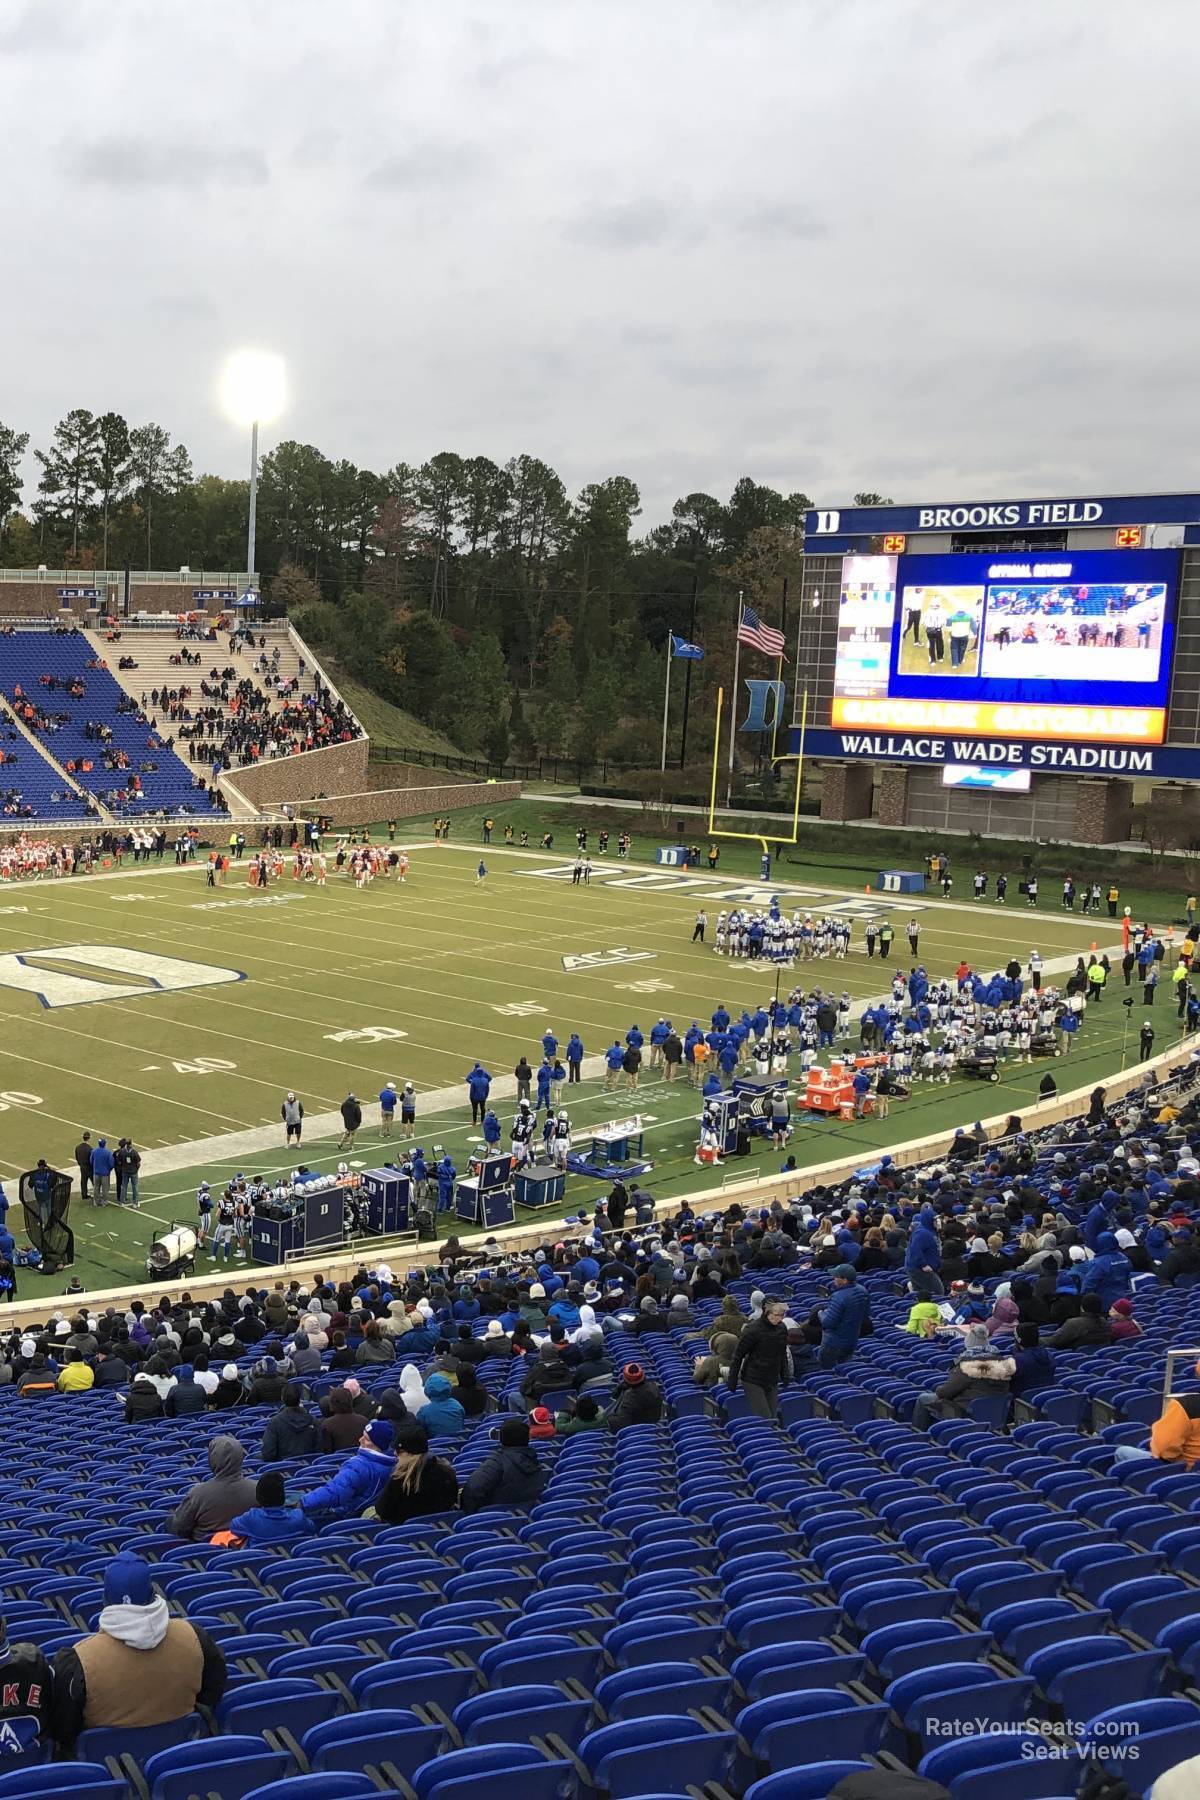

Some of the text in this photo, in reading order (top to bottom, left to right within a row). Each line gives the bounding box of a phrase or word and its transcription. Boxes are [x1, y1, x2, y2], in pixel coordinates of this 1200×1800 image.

[816, 510, 841, 534] D
[918, 502, 1104, 529] BROOKS FIELD
[885, 537, 904, 551] 25
[1118, 529, 1140, 546] 25
[841, 735, 1154, 771] WALLACE WADE STADIUM
[512, 862, 932, 920] DUKE
[561, 946, 658, 972] ACC
[322, 1025, 409, 1044] 50
[171, 1056, 238, 1075] 40
